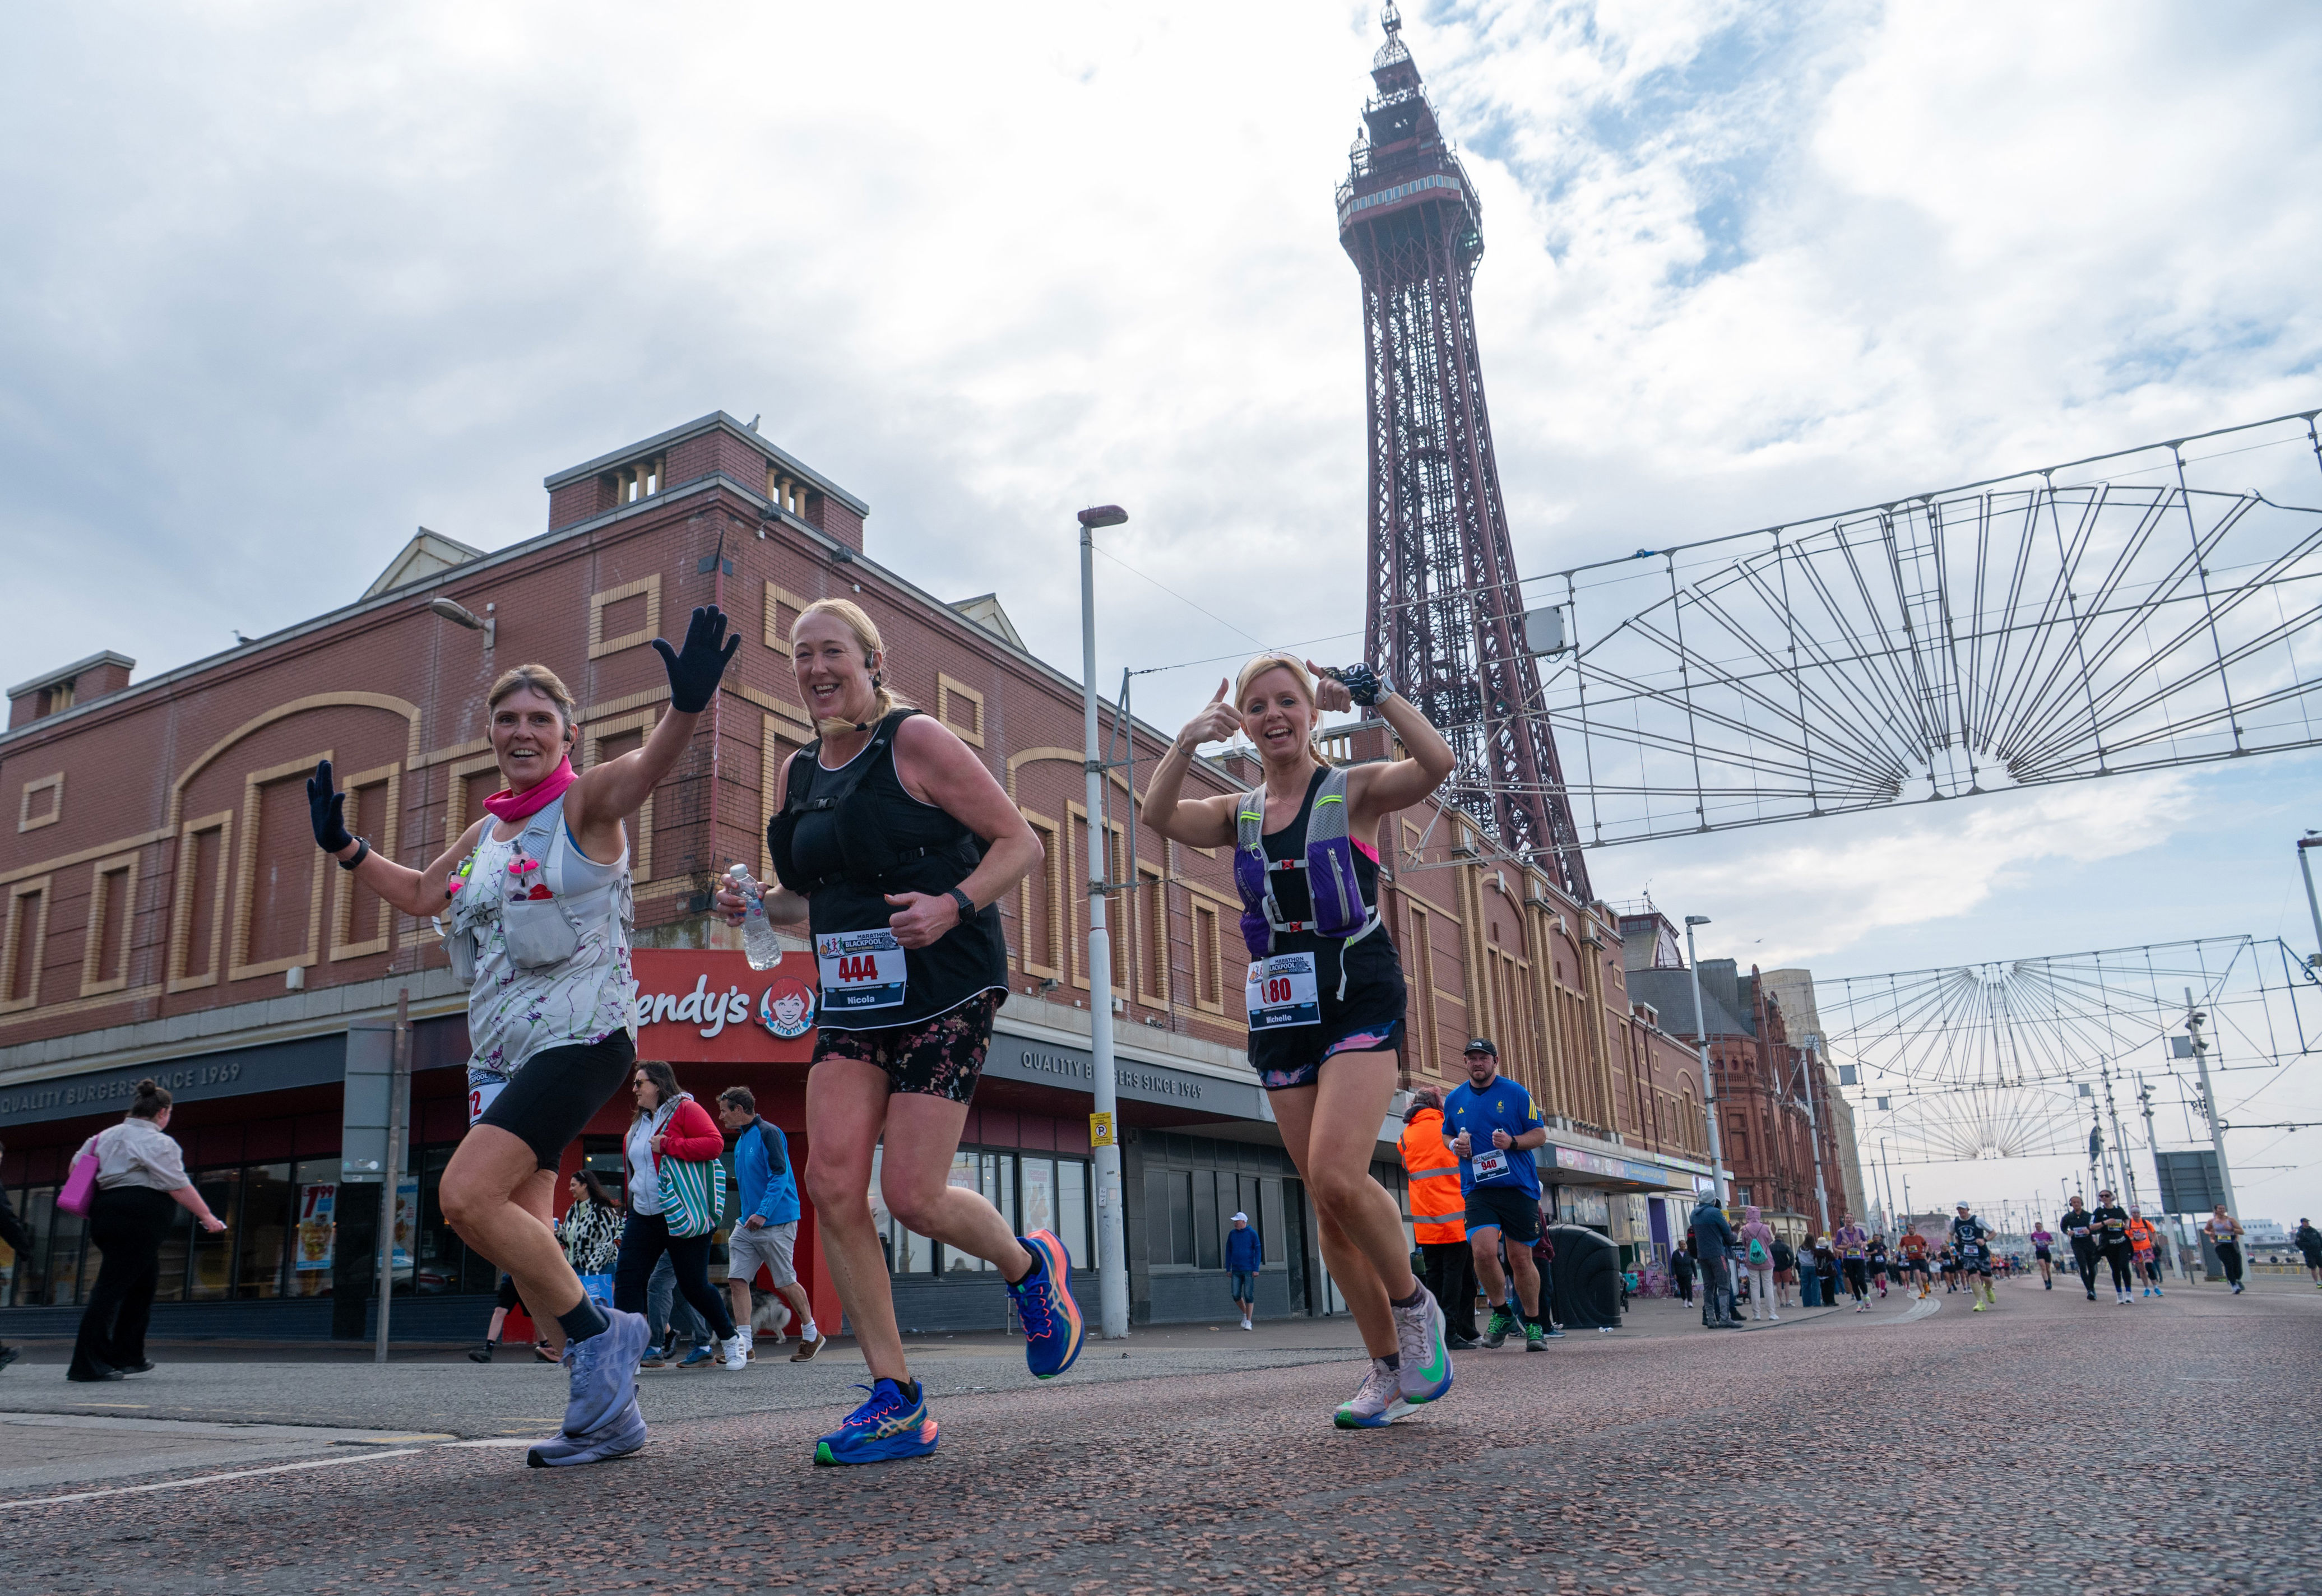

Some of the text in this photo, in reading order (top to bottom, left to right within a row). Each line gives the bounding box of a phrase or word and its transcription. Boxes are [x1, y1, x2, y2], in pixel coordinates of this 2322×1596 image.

[845, 938, 882, 948] BLACKPOOL
[838, 955, 878, 982] 444
[1269, 962, 1296, 971] LACKPOOL
[632, 974, 750, 1037] endy's
[847, 995, 875, 1004] Nicola
[1266, 1014, 1292, 1023] Michelle
[1022, 1051, 1202, 1098] QUALITY BGERS SINCE 1969
[1, 1063, 241, 1114] QUALITY BURGERS INCE 1969
[1481, 1159, 1497, 1171] 940
